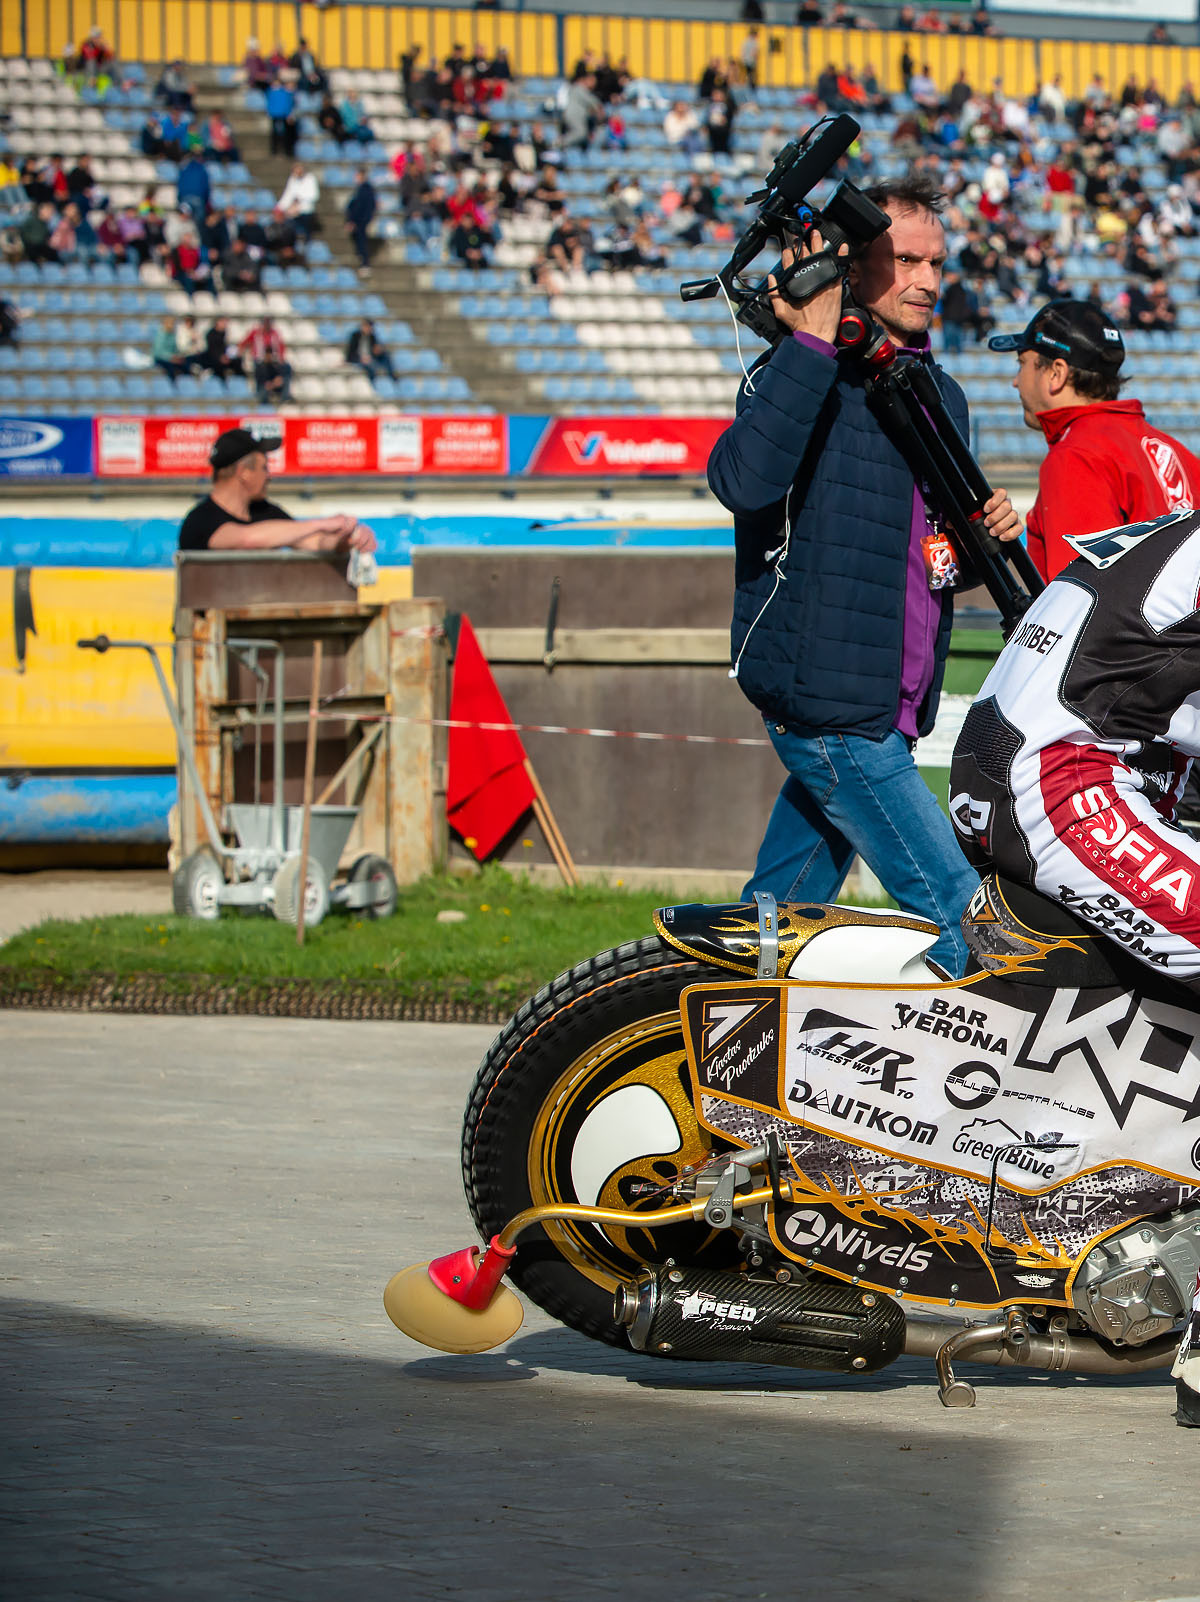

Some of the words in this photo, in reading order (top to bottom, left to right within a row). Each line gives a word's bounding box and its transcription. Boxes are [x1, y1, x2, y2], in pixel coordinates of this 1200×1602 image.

[794, 261, 821, 279] SONY
[1068, 824, 1149, 900] DAUGAVPILS
[1072, 788, 1195, 913] SOFIA
[1062, 886, 1171, 968] VERONA
[1097, 893, 1156, 937] BAR
[896, 1003, 1009, 1056] VERONA
[930, 998, 988, 1029] BAR
[797, 1043, 852, 1067] FASTEST
[850, 1061, 881, 1076] WAY
[897, 1088, 914, 1100] TO
[1001, 1089, 1051, 1106] SPORTA
[1053, 1099, 1096, 1120] KLUBS
[820, 1222, 933, 1273] Nivels
